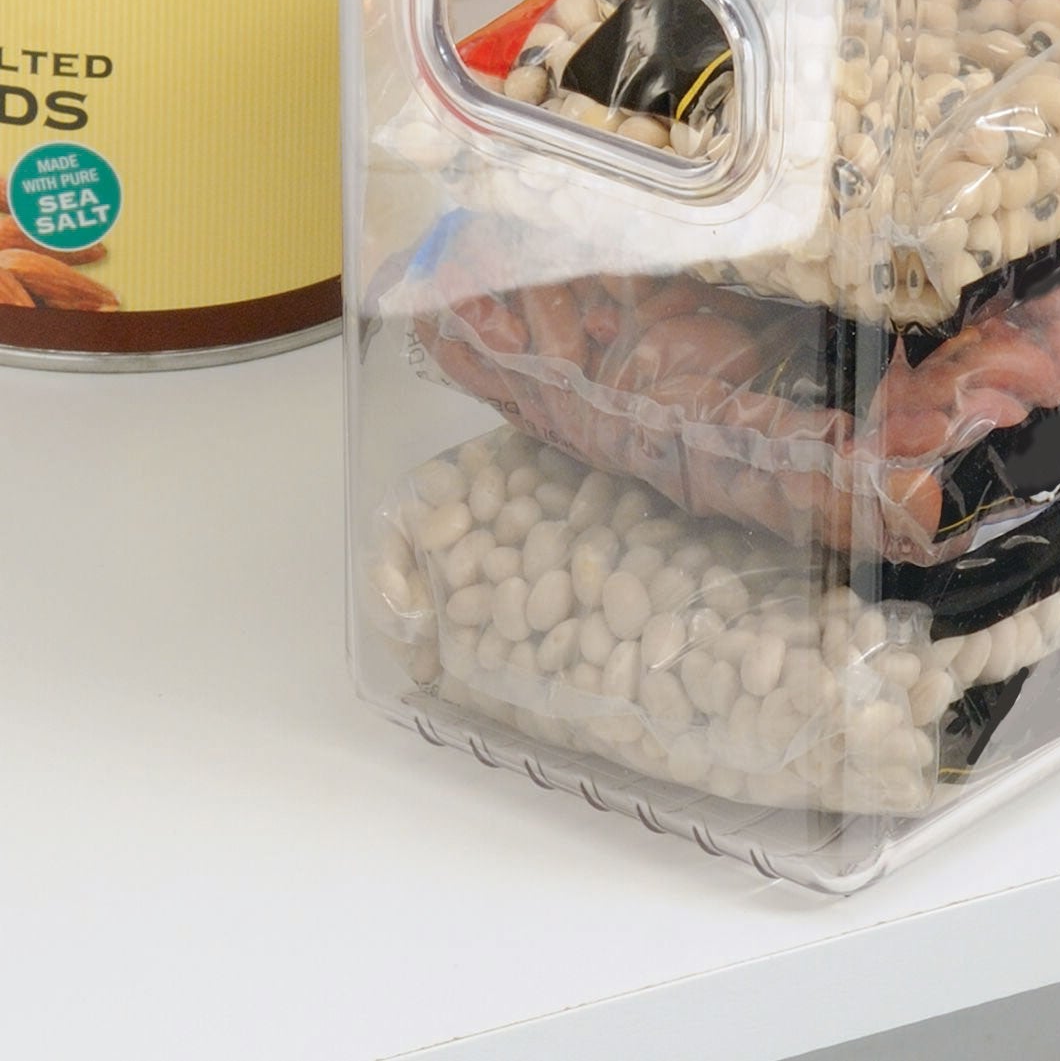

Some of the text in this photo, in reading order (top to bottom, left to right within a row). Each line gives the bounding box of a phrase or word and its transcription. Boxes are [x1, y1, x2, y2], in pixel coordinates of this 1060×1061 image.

[36, 153, 80, 174] MADE
[22, 168, 100, 194] WITH PURE
[38, 188, 99, 214] SEA
[35, 204, 111, 235] SALT
